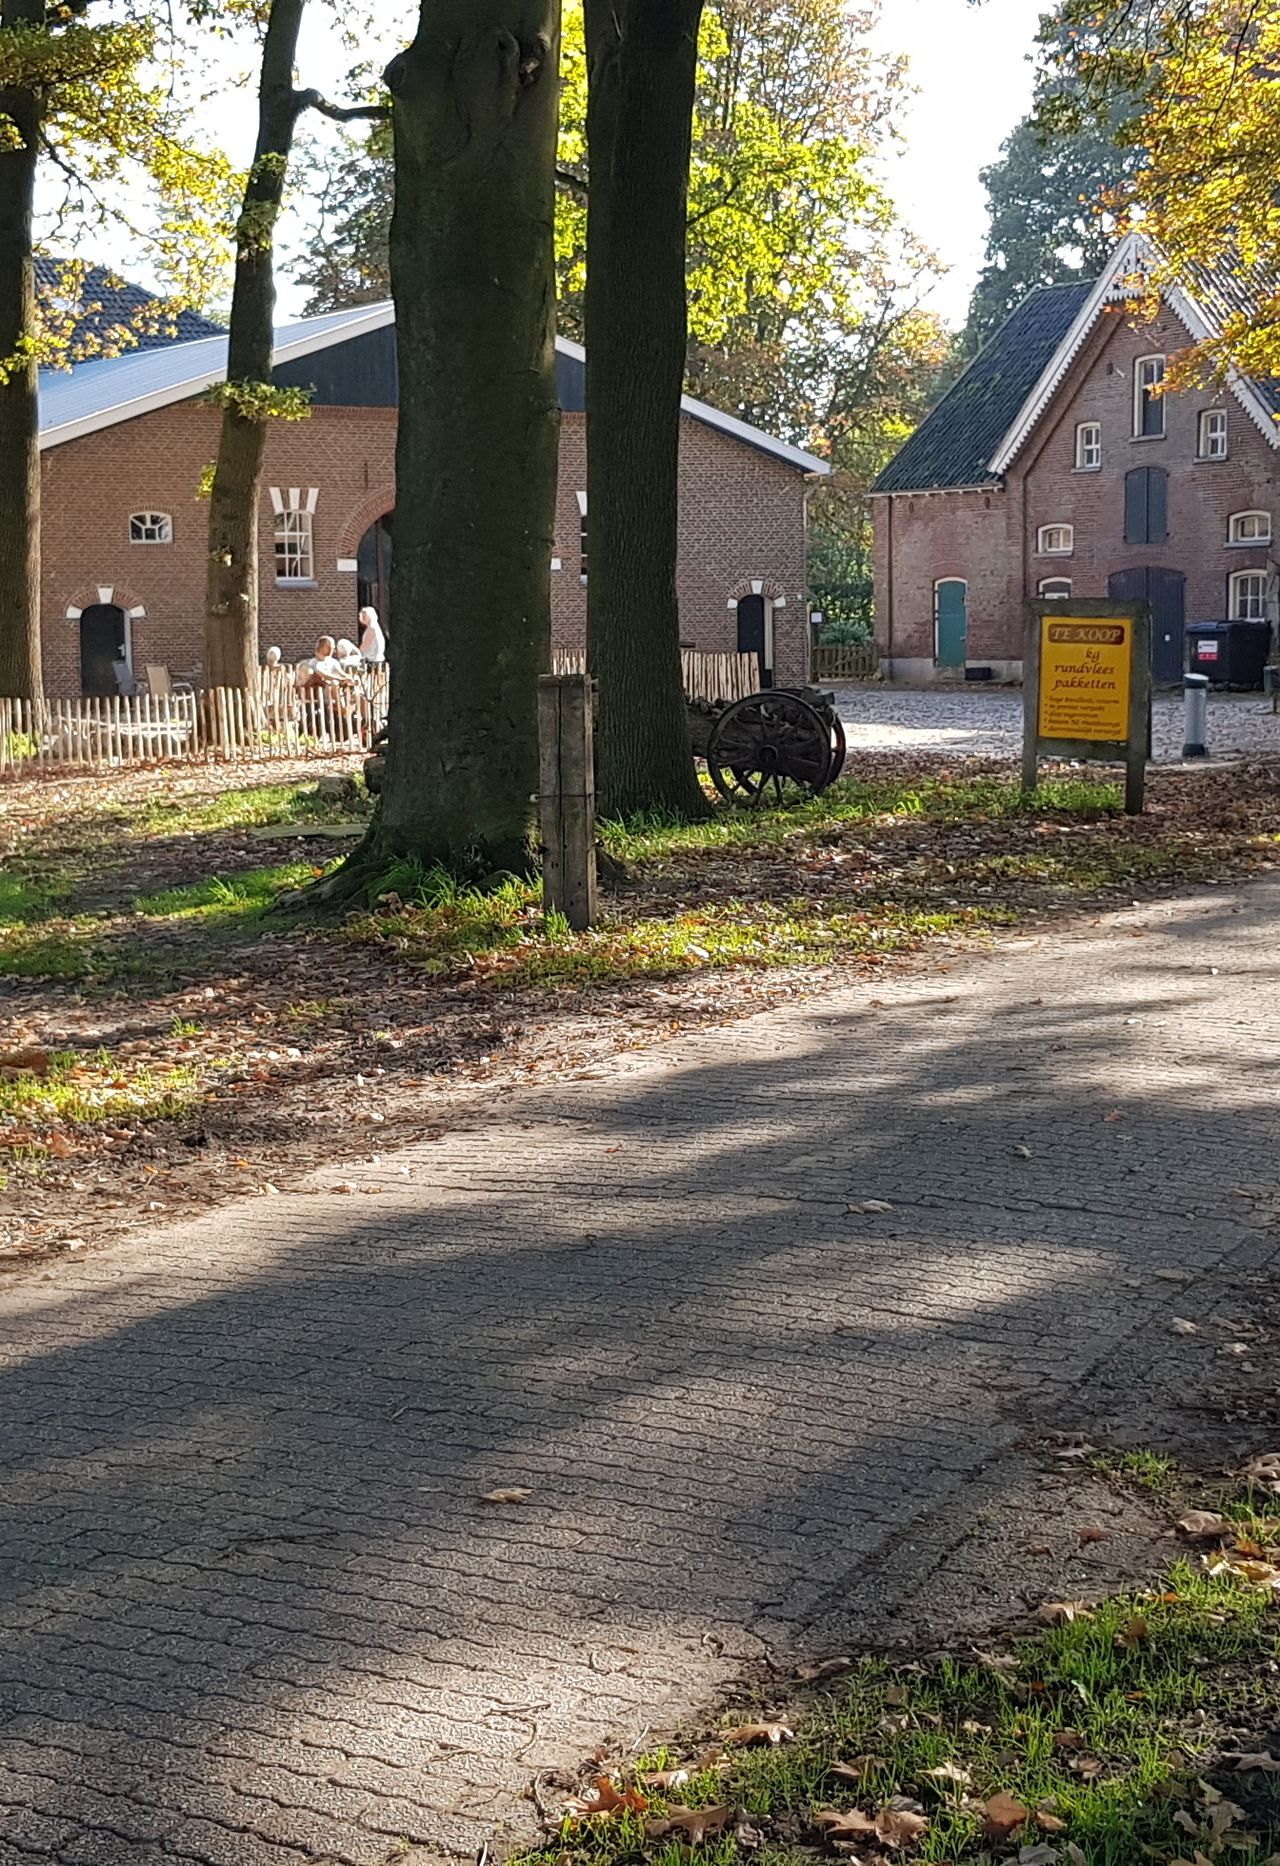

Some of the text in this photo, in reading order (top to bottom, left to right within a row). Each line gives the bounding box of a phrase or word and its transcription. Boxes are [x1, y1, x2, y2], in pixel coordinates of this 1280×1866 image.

[1052, 628, 1120, 641] TE KOOP
[1085, 647, 1100, 663] kg
[1054, 662, 1115, 675] rundvlees
[1051, 676, 1116, 691] pakketten
